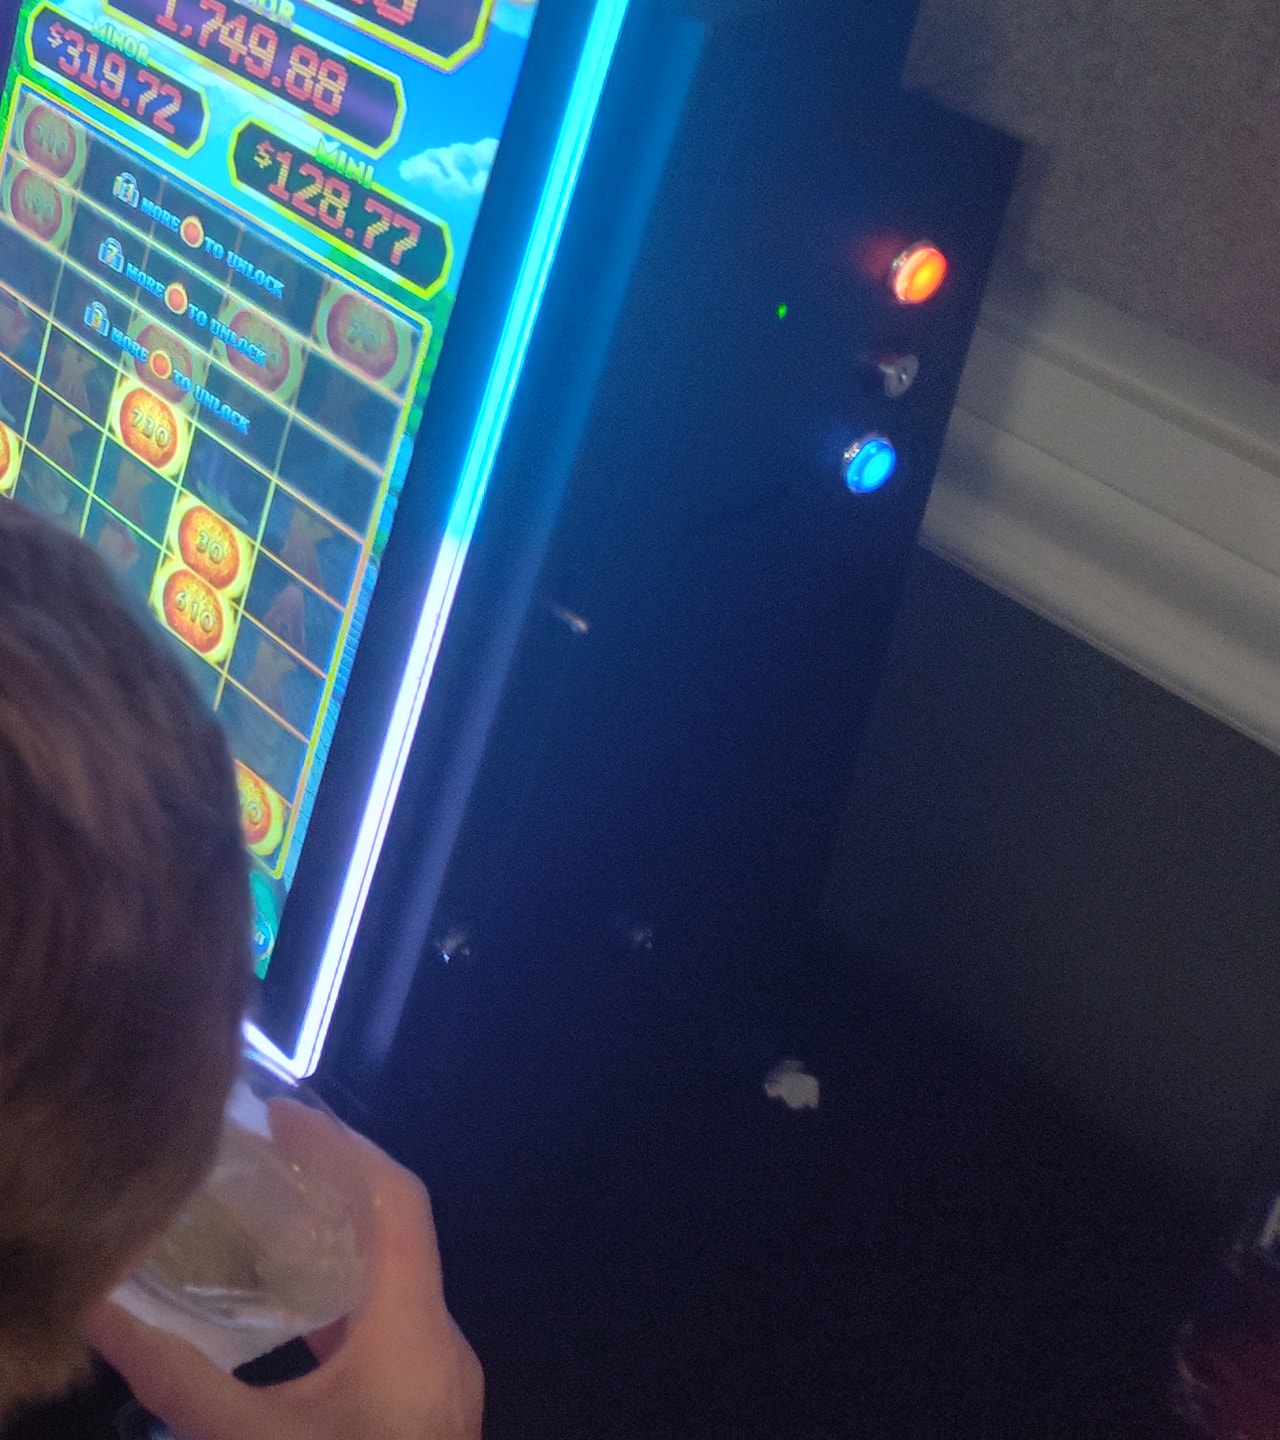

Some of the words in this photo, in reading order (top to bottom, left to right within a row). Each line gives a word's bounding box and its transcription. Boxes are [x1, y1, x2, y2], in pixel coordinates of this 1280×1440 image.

[47, 22, 182, 134] $319.72
[90, 16, 151, 67] MINOR
[254, 140, 421, 265] $128.77
[315, 138, 374, 190] MINI
[140, 197, 181, 233] MORE
[204, 236, 224, 260] TO
[226, 251, 286, 300] UNLOCK
[124, 262, 165, 300] MORE
[187, 303, 208, 328] TO
[210, 317, 267, 368] UNLOCK
[109, 326, 149, 364] MORE
[172, 369, 192, 394] TO
[194, 385, 252, 436] UNLOCK
[196, 530, 225, 564] 30
[175, 591, 215, 633] 610
